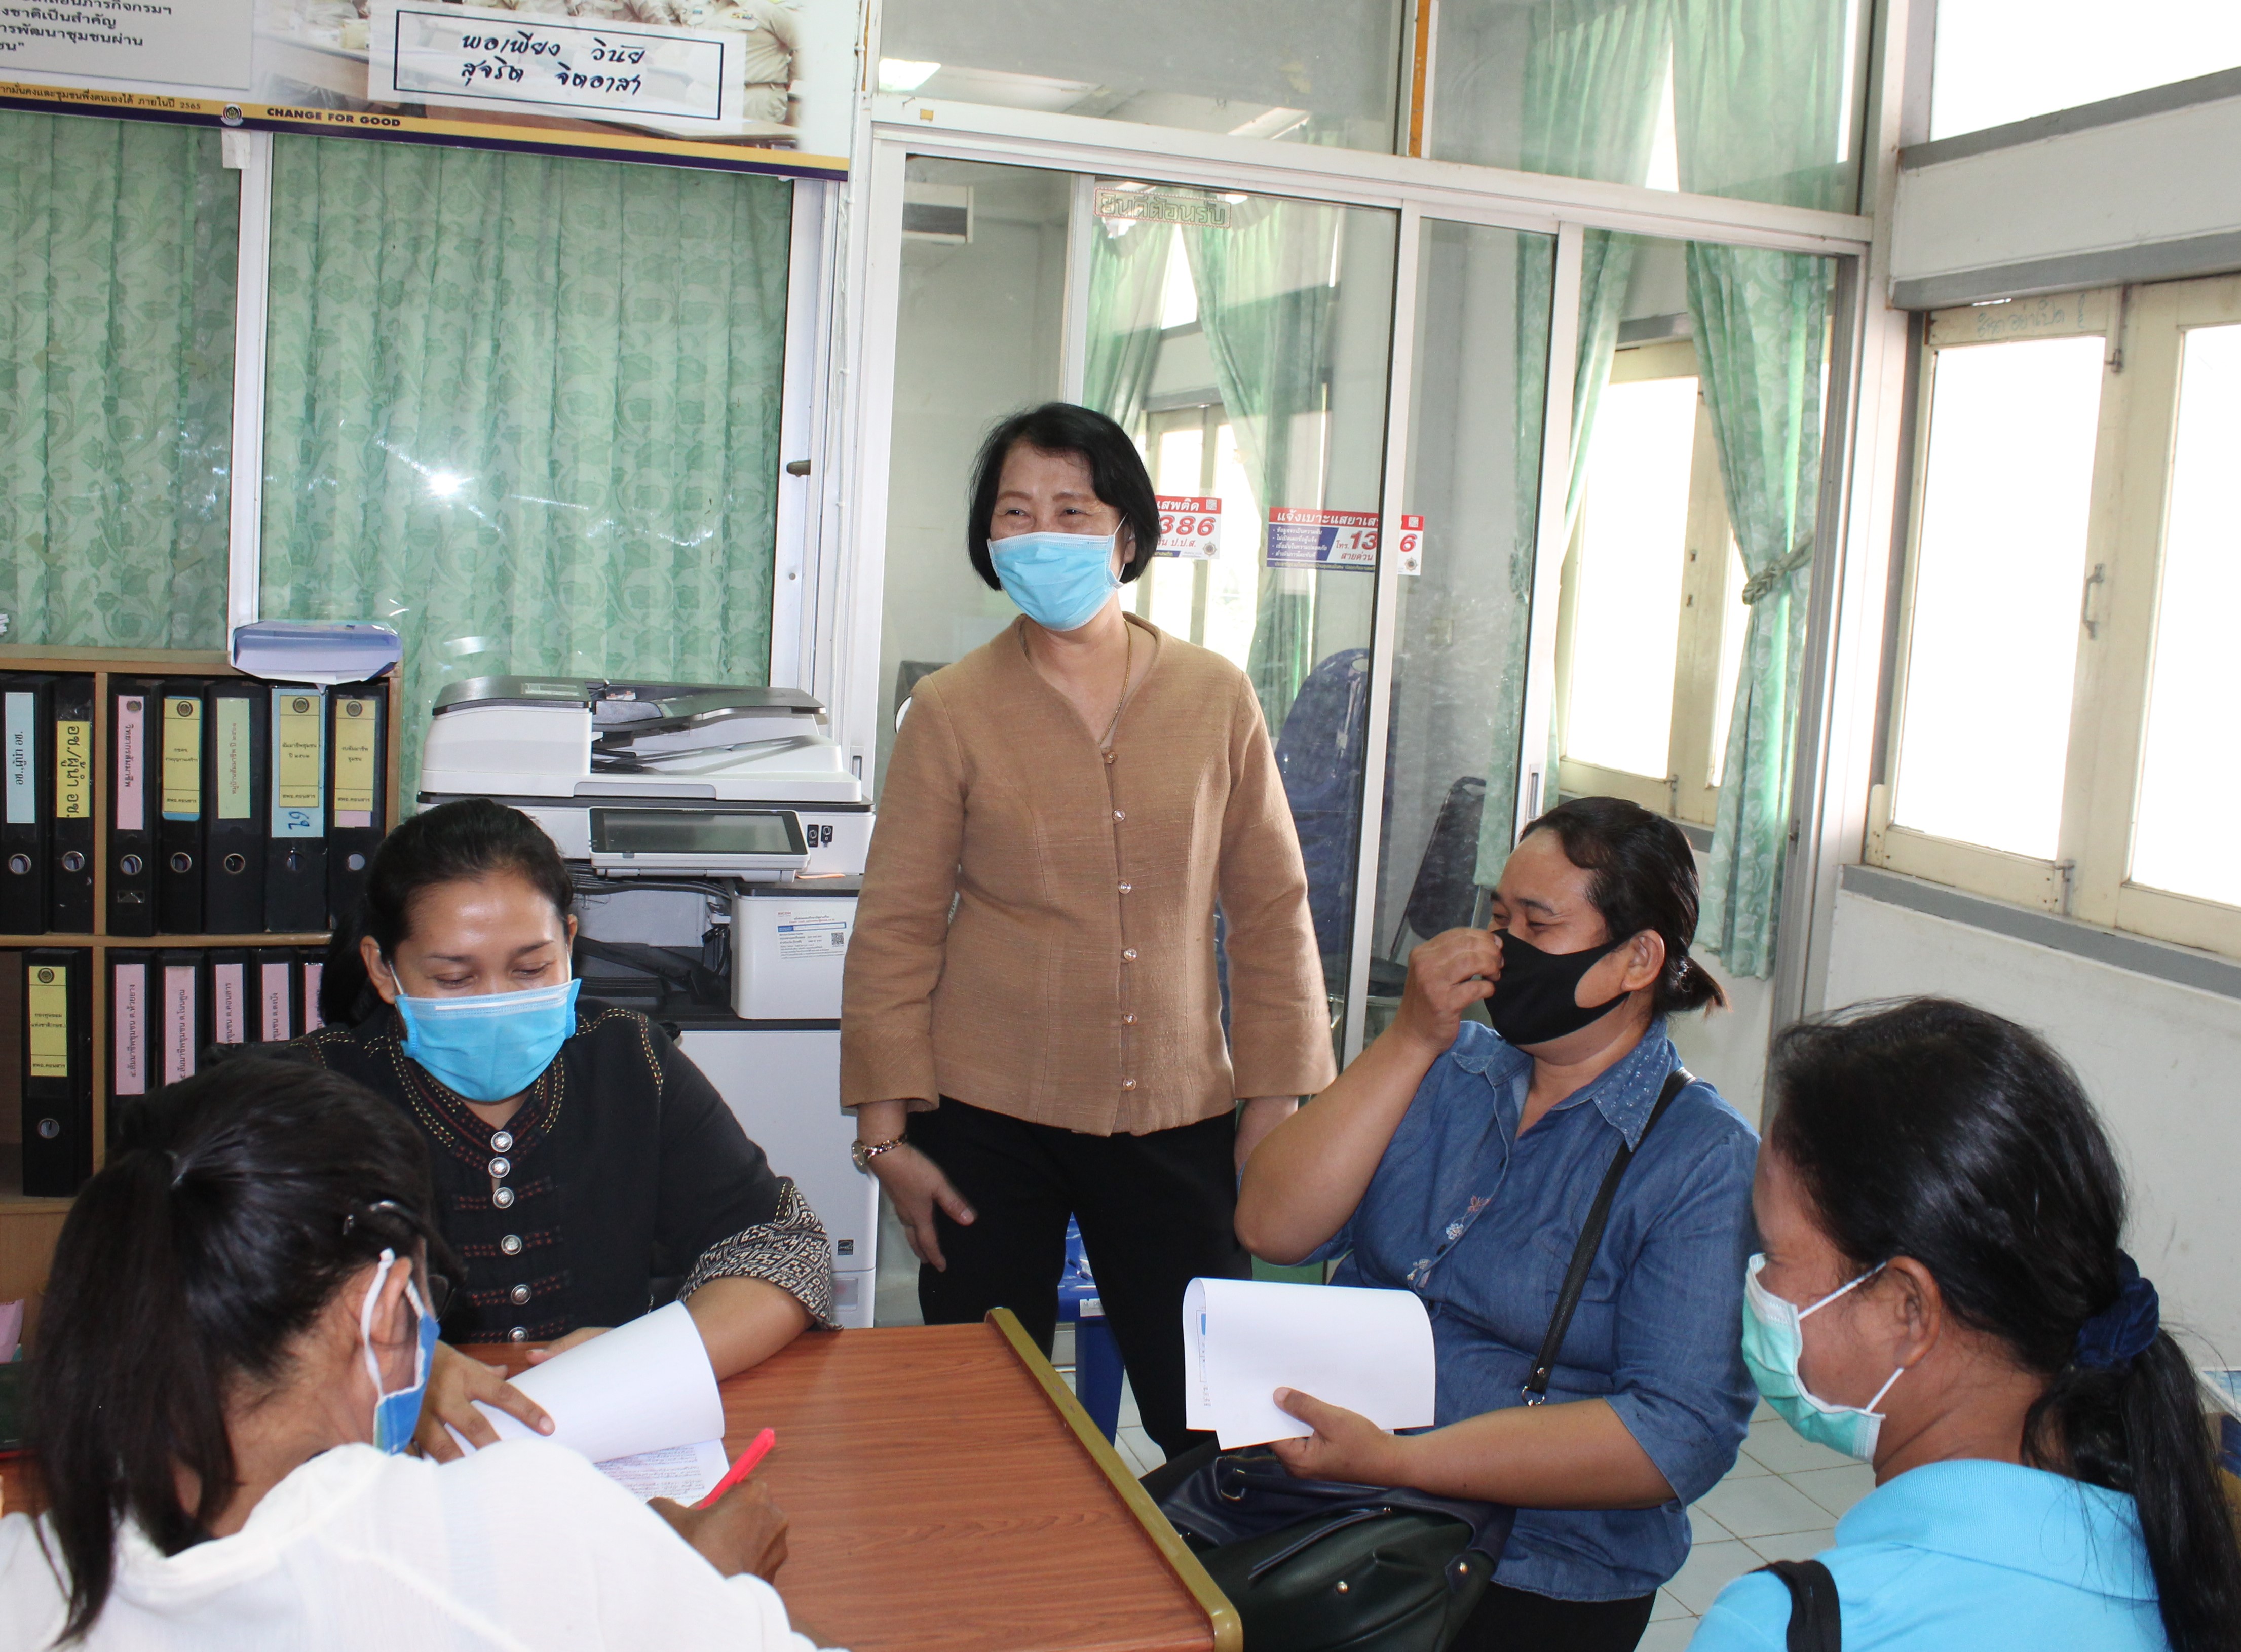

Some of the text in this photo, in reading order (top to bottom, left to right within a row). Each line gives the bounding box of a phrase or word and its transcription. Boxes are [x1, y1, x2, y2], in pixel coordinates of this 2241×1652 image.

[462, 30, 645, 63] พอเพียง วินัย
[461, 56, 642, 95] สุจริต จิตอาสา
[267, 107, 401, 127] CHANGE FOR GOOD
[1101, 193, 1225, 225] ยินดีต้อนรับ
[1277, 509, 1378, 527] แจ้งเบาะแสยาเส
[1336, 540, 1349, 549] โทร.
[61, 726, 86, 817] อช./ผู้นำ อช.
